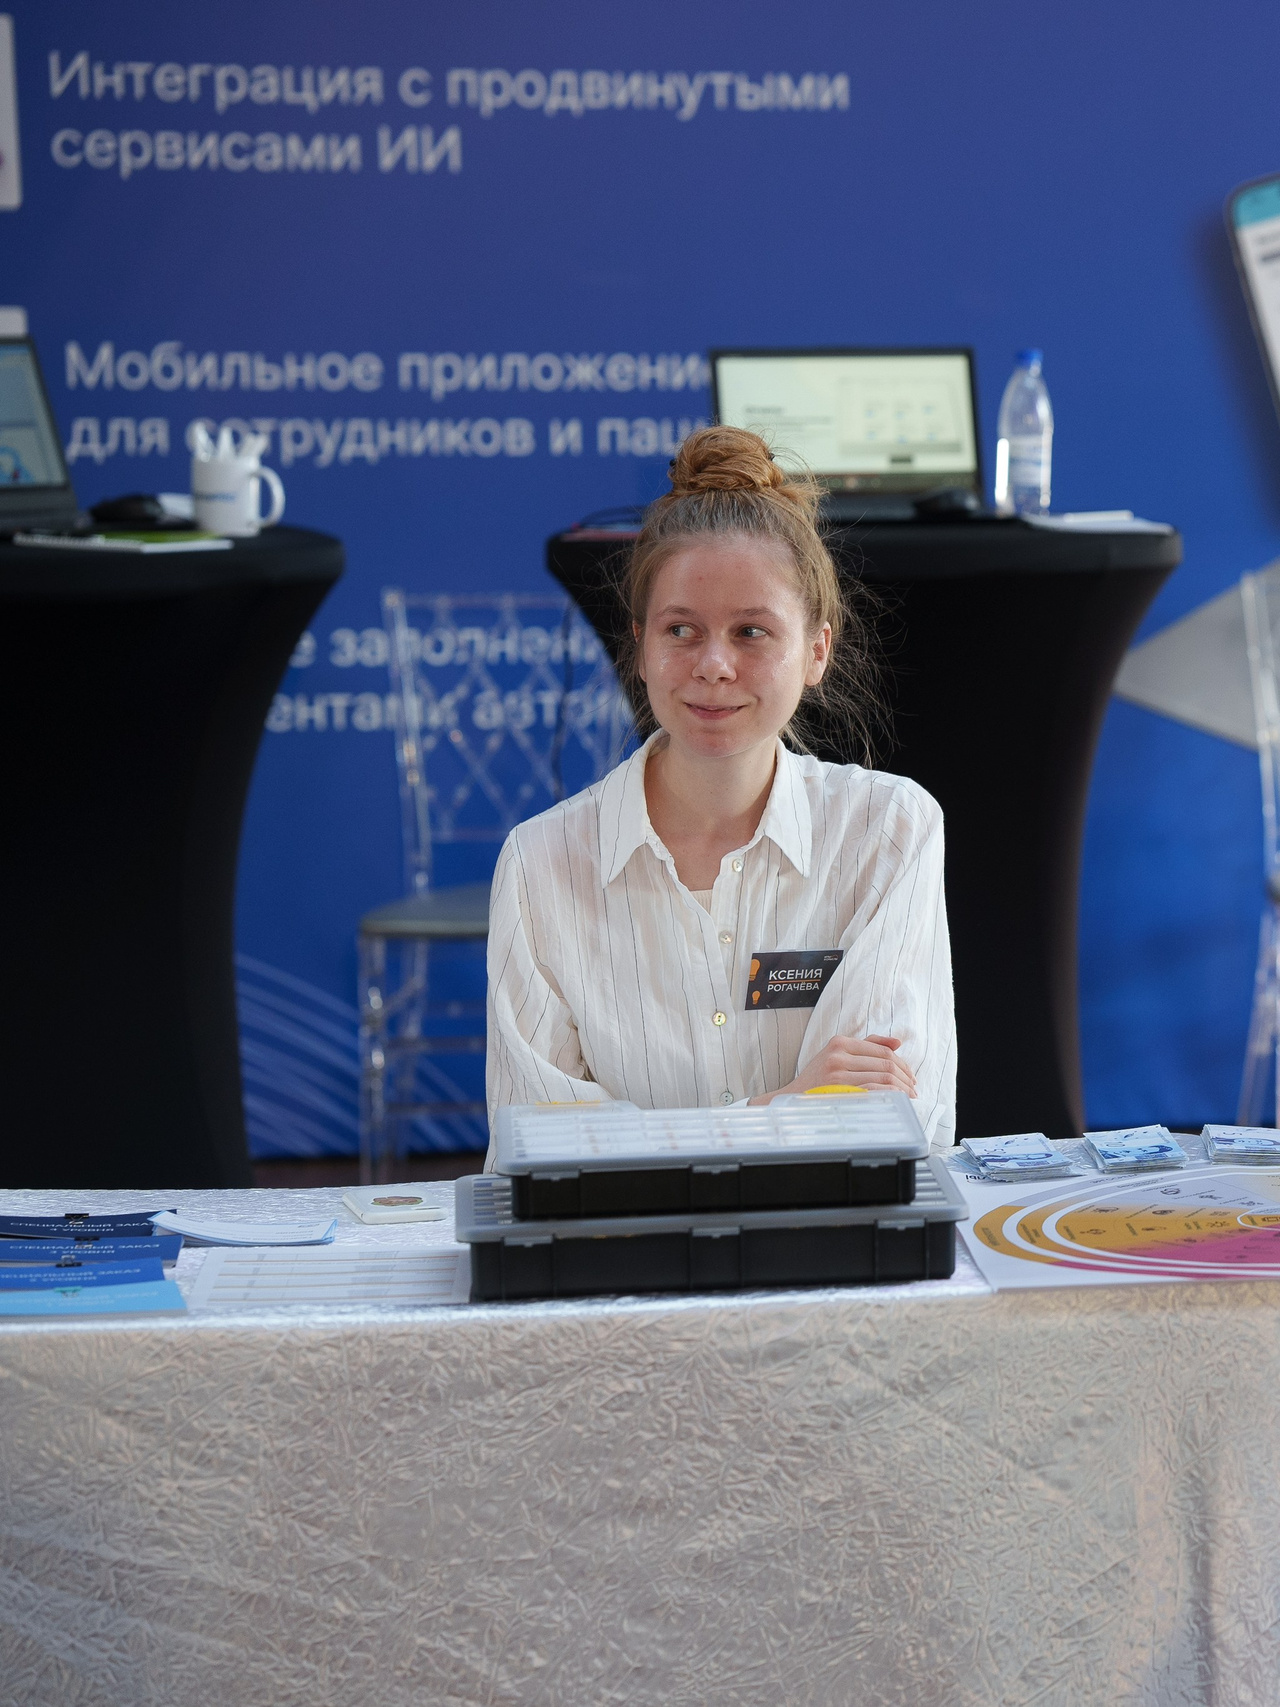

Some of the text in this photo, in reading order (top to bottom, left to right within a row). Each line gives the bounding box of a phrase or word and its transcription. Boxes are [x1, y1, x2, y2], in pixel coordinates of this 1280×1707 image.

[48, 48, 850, 121] Интеграция с продвинутыми
[50, 124, 463, 181] сервисами ИИ
[65, 340, 711, 401] Мобильное приложени
[65, 416, 170, 465] для
[549, 417, 582, 457] и
[597, 417, 707, 457] пац
[329, 627, 602, 667] заполнени
[264, 692, 459, 733] ентами
[767, 981, 820, 992] РОГАЧЁВА
[768, 968, 823, 981] КСЕНИЯ
